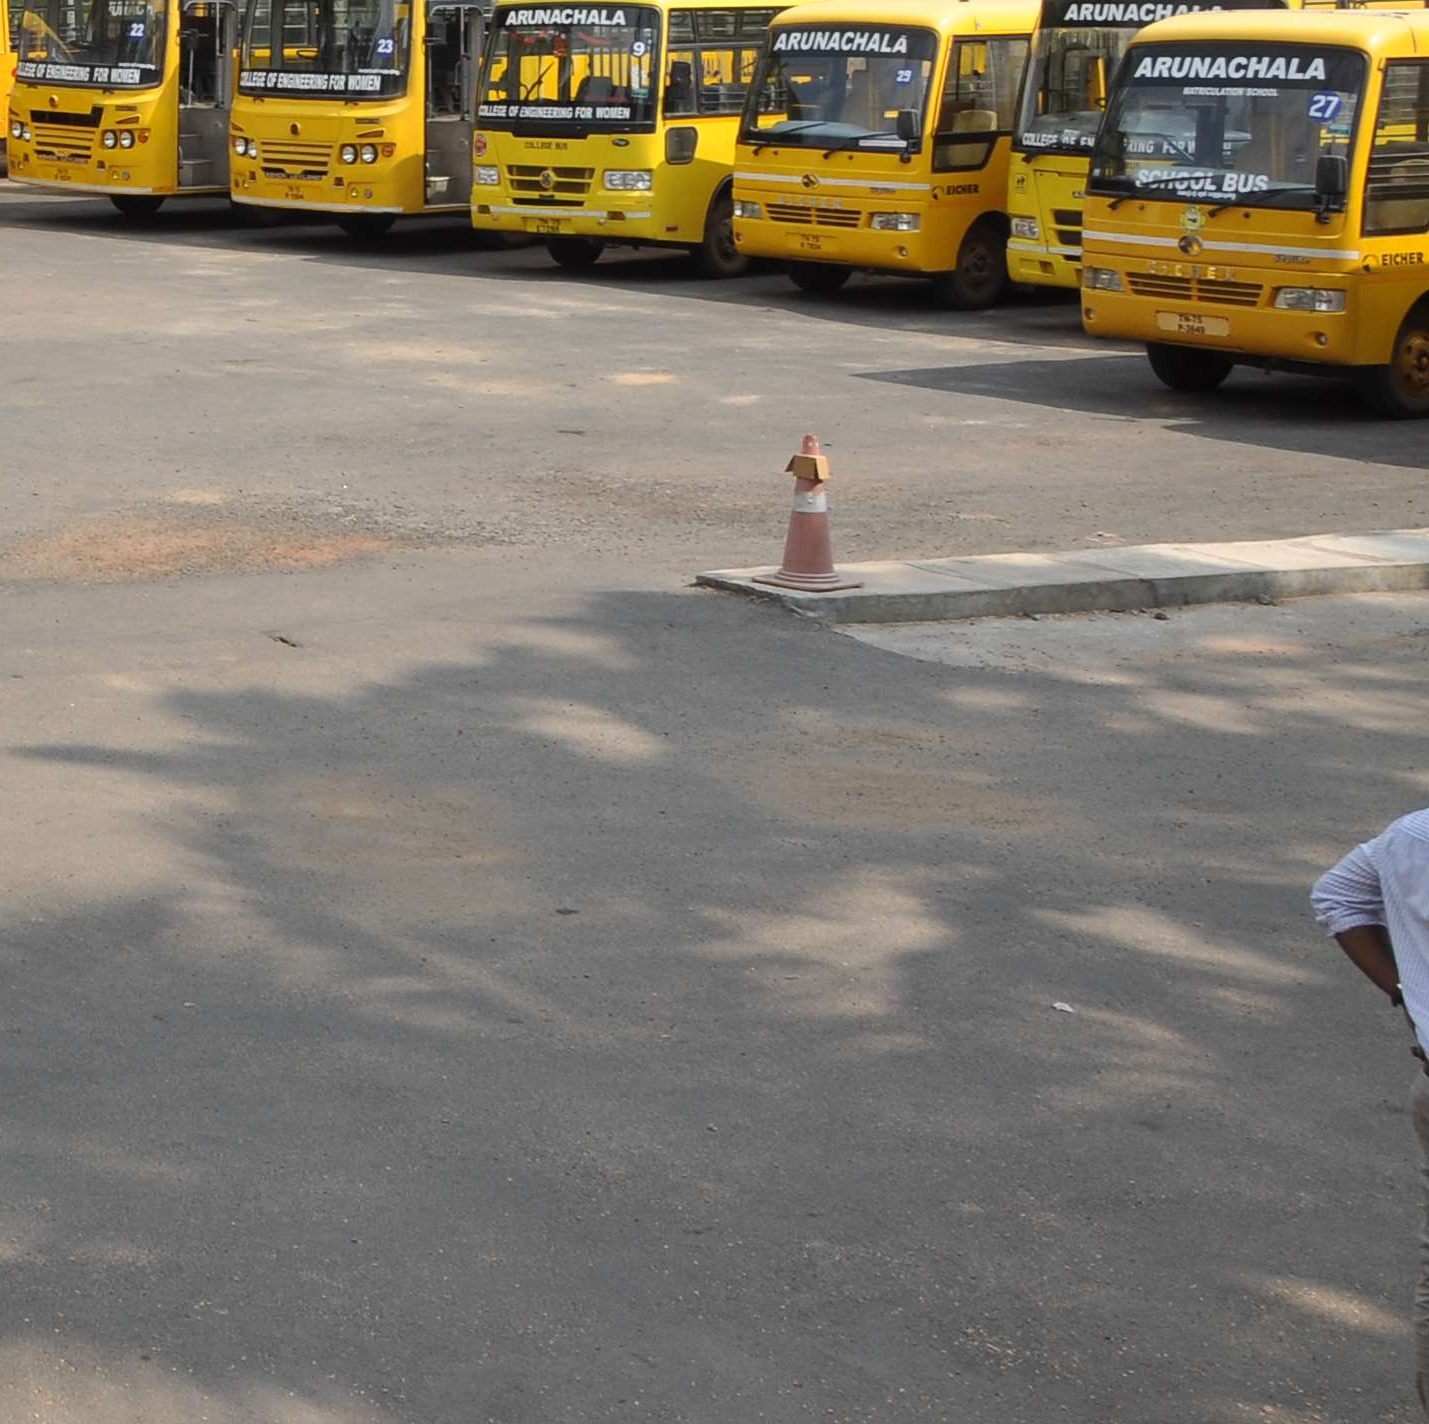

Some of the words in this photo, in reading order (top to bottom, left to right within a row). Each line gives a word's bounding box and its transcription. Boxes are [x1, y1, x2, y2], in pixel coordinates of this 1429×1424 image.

[505, 9, 626, 26] ARUNACHALA
[129, 24, 144, 37] 22
[377, 39, 393, 53] 23
[632, 41, 646, 57] 9
[774, 31, 909, 54] ARUNACHALA
[36, 63, 46, 78] OF
[46, 64, 90, 82] ENGINEERING
[93, 67, 109, 82] FOR
[110, 67, 141, 84] WOMEN
[896, 69, 912, 83] 29
[1134, 56, 1326, 80] ARUNACHALA
[267, 73, 277, 88] OF
[277, 73, 328, 90] ENGINEERING
[329, 74, 345, 90] FOR
[347, 74, 381, 91] WOMEN
[1183, 87, 1243, 96] MATRICULATION
[1246, 88, 1279, 97] SCHOOL
[508, 105, 519, 117] OF
[519, 105, 573, 119] ENGINEERING
[575, 106, 593, 119] FOR
[596, 106, 631, 119] WOMEN
[1308, 95, 1339, 119] 27
[1135, 169, 1218, 191] SCHOOL
[1222, 173, 1270, 193] BUS
[946, 184, 980, 196] EICHER
[1381, 253, 1425, 266] EICHER
